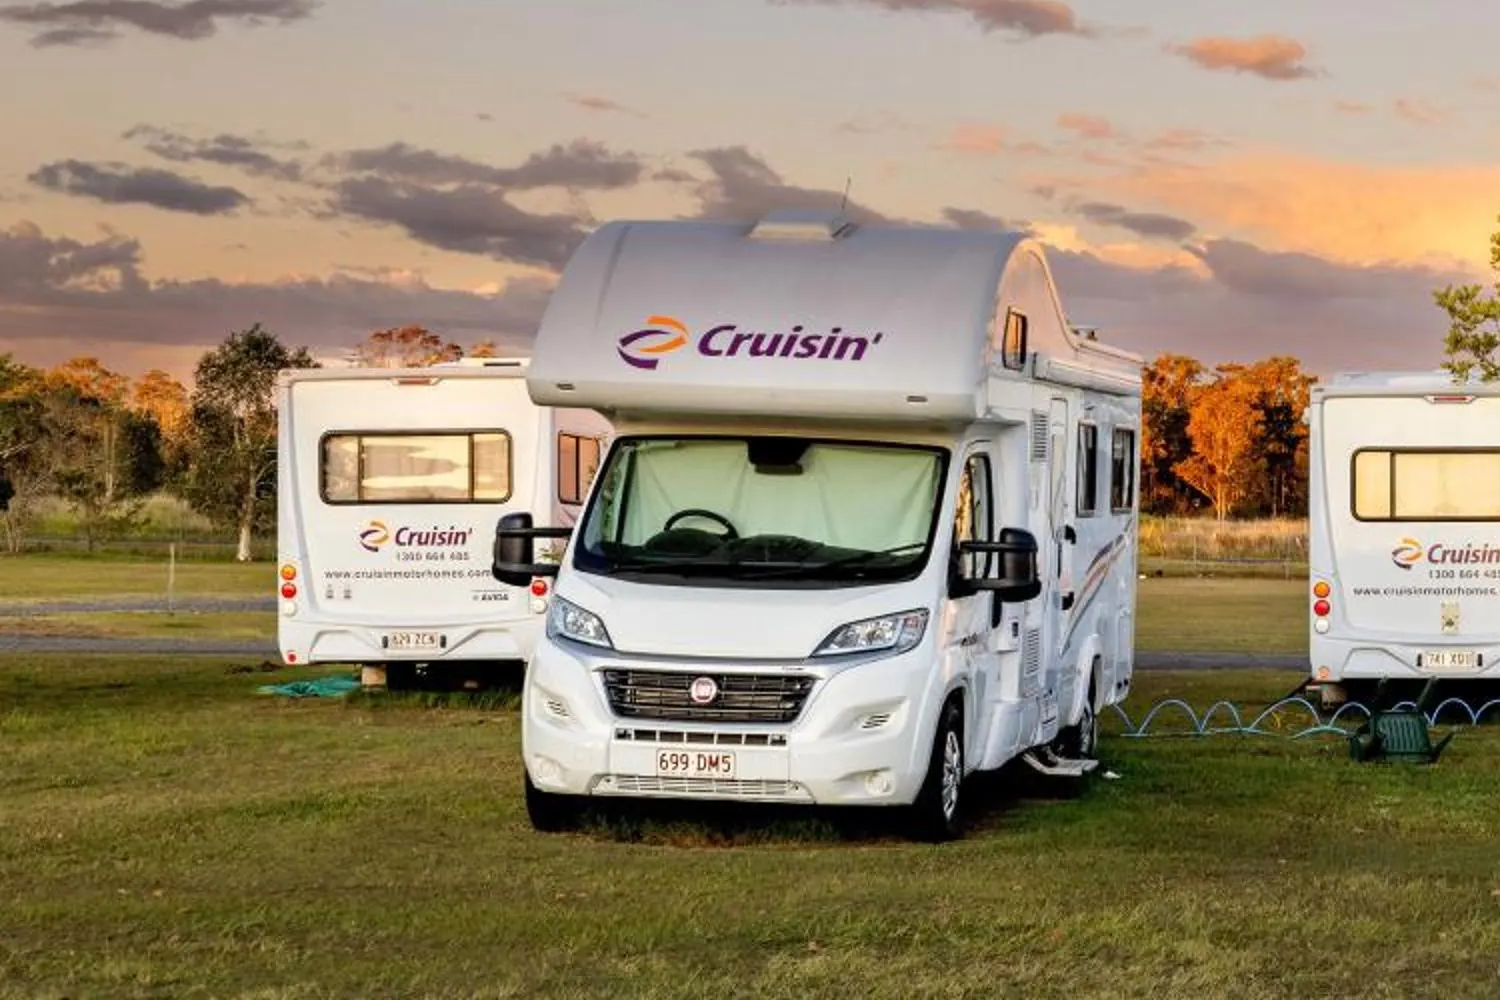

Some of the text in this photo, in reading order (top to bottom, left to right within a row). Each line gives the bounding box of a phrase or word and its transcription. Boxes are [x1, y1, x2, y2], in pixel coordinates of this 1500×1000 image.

[697, 325, 883, 361] Cruisin'
[395, 526, 473, 546] Cruisin'
[324, 567, 493, 579] www.cruisinmotorhomes.com
[659, 753, 731, 773] 699 DM5
